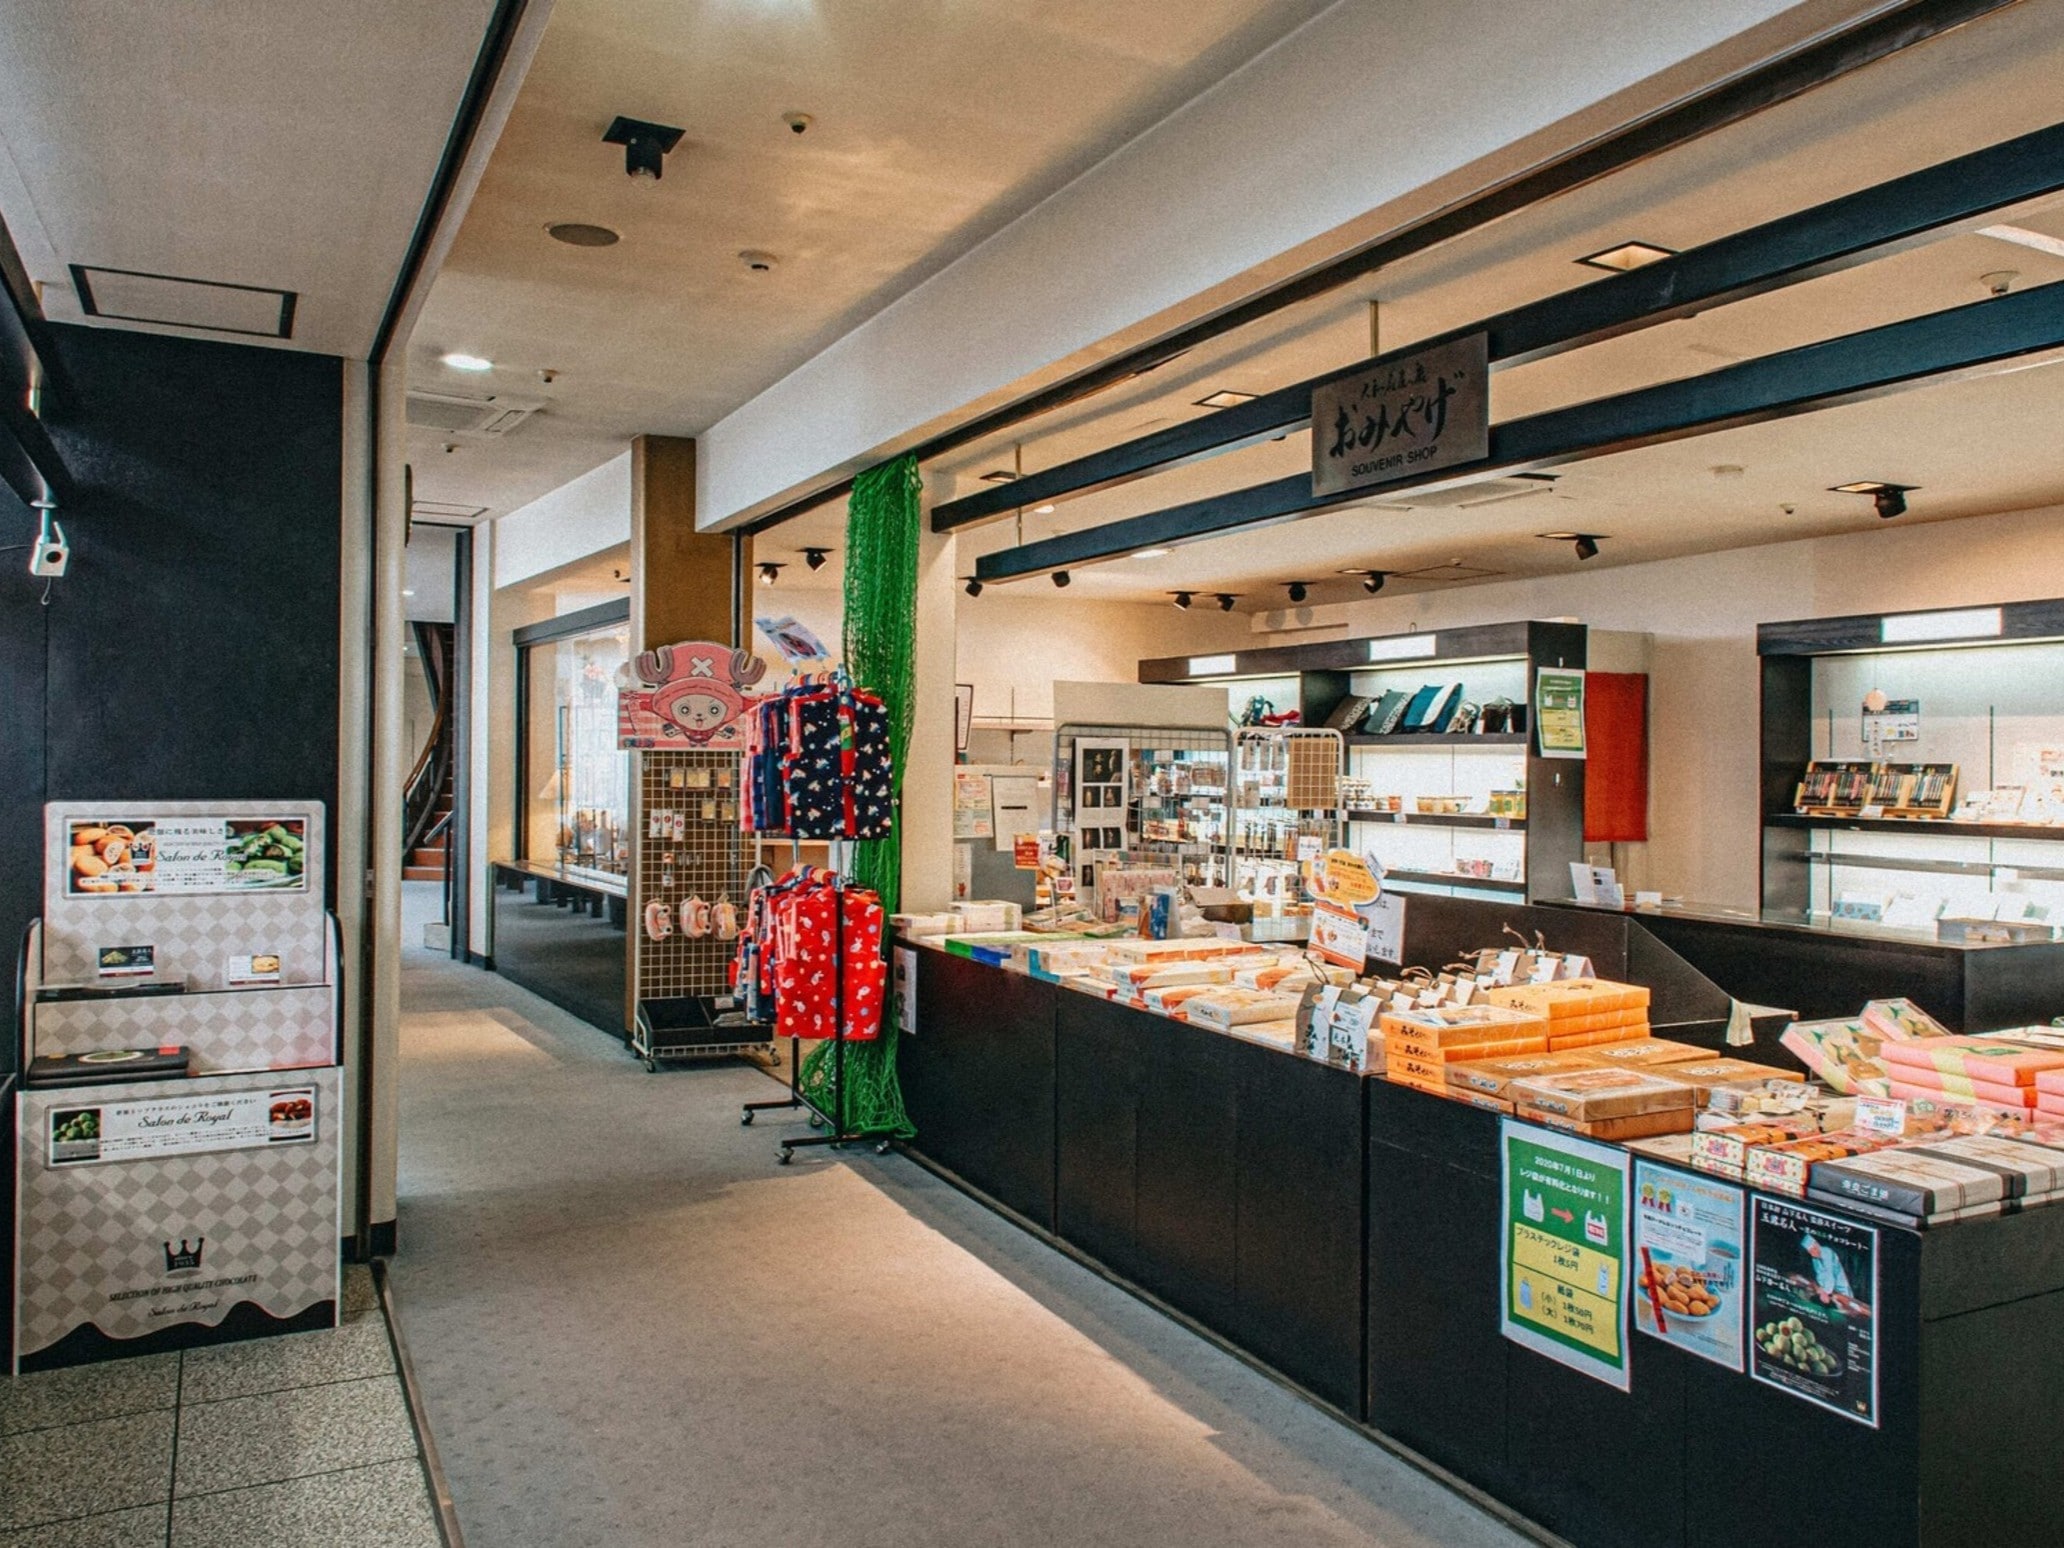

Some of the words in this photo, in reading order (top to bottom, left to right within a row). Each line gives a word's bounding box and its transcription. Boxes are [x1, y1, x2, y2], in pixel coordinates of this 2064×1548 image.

[1352, 454, 1403, 477] SOUVENIR
[1407, 445, 1438, 464] SHOP
[156, 850, 190, 862] Salon
[193, 849, 207, 862] de
[138, 1114, 175, 1129] Salon
[176, 1113, 192, 1125] de
[193, 1108, 235, 1126] Royal
[1516, 1226, 1581, 1258] プラスチックレジ袋
[109, 1288, 150, 1302] SELECTION
[151, 1287, 161, 1296] OF
[162, 1285, 182, 1295] HIGH
[183, 1280, 213, 1294] QUALITY
[214, 1274, 259, 1287] CHOCOLATE
[149, 1305, 176, 1317] Salon
[187, 1298, 220, 1313] Royal
